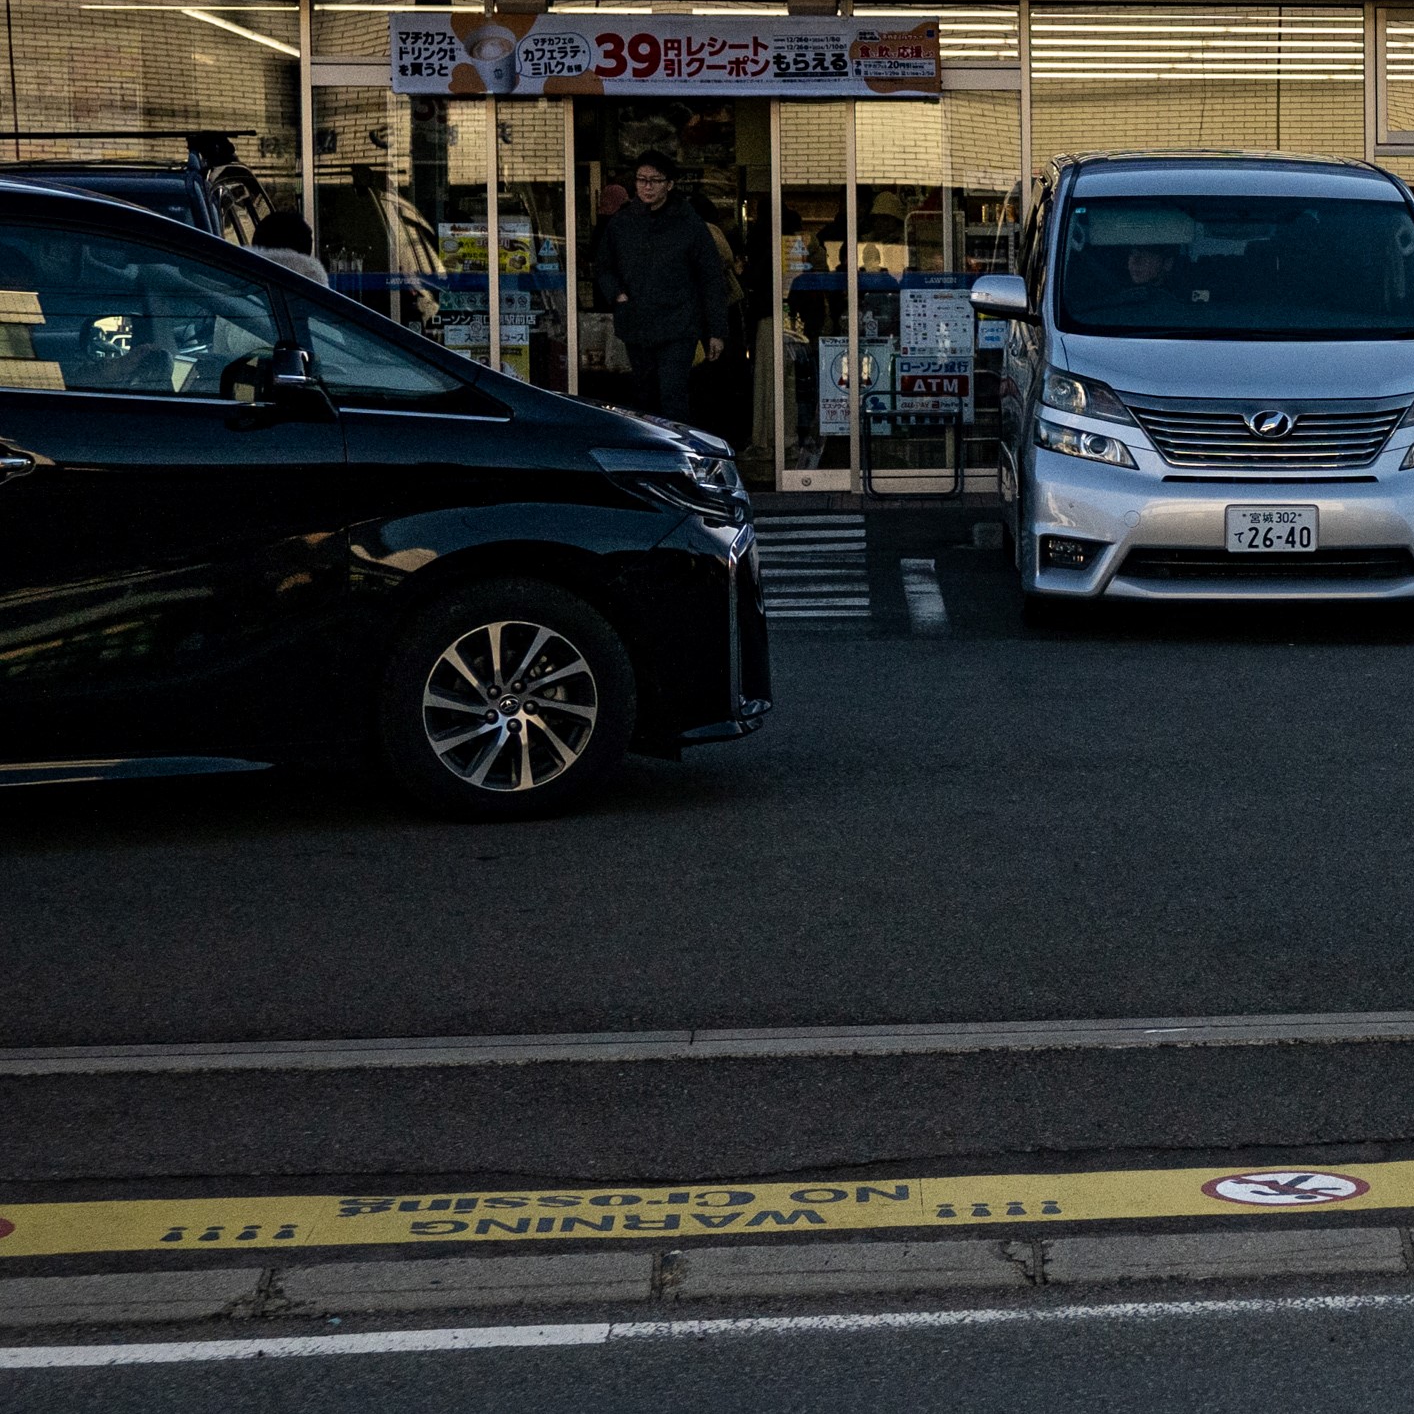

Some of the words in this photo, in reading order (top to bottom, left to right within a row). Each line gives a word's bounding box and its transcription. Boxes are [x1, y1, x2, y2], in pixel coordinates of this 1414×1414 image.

[398, 31, 455, 46] マチカフェ
[532, 36, 575, 46] マチカフェの
[686, 36, 770, 58] レシート
[594, 32, 662, 79] 39
[772, 52, 848, 73] もらえる
[398, 62, 449, 77] を買うと
[685, 56, 771, 78] クーポン
[431, 314, 537, 326] ローソン河口駅前店
[900, 360, 969, 373] ローソン銀行
[912, 378, 959, 394] ATM
[1249, 512, 1274, 524] 宮城
[1275, 511, 1297, 524] 302
[1233, 531, 1245, 543] て
[1247, 526, 1311, 548] 26-40
[791, 1185, 910, 1202] NO
[338, 1189, 756, 1217] Crossing
[410, 1209, 827, 1236] WARNING
